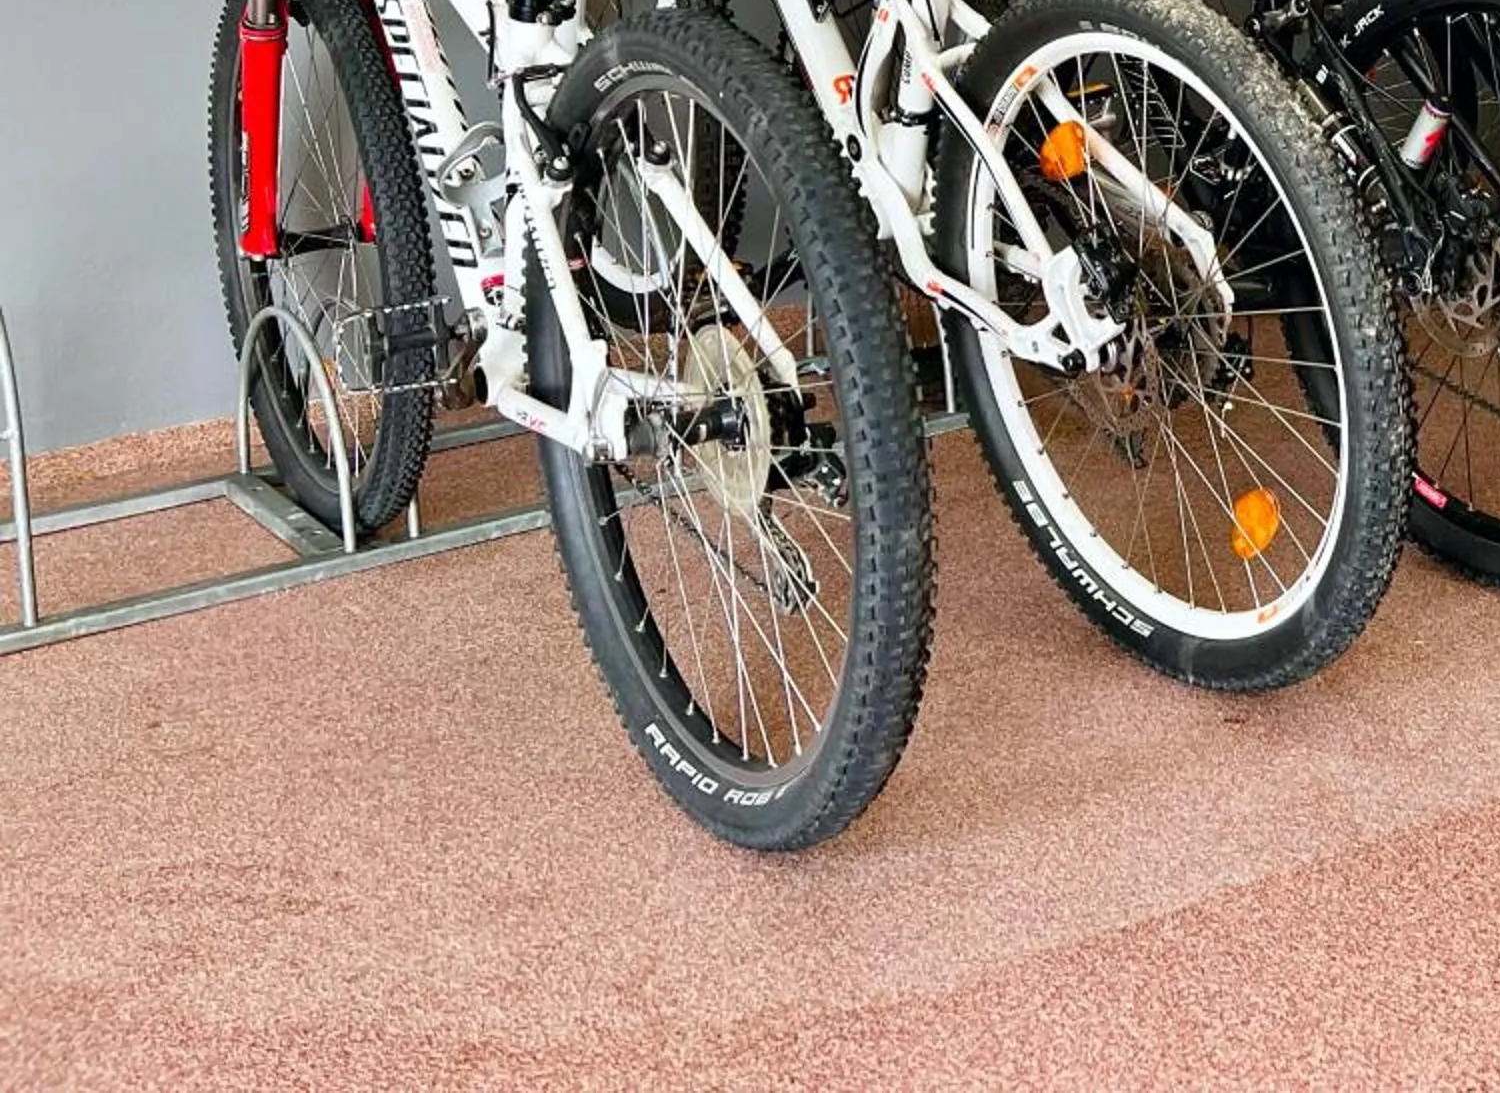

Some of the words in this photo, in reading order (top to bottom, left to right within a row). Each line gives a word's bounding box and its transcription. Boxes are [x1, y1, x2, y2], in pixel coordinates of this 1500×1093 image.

[1353, 3, 1385, 37] JACK
[1011, 480, 1155, 638] SCHWALBE
[644, 722, 720, 796] RAPID
